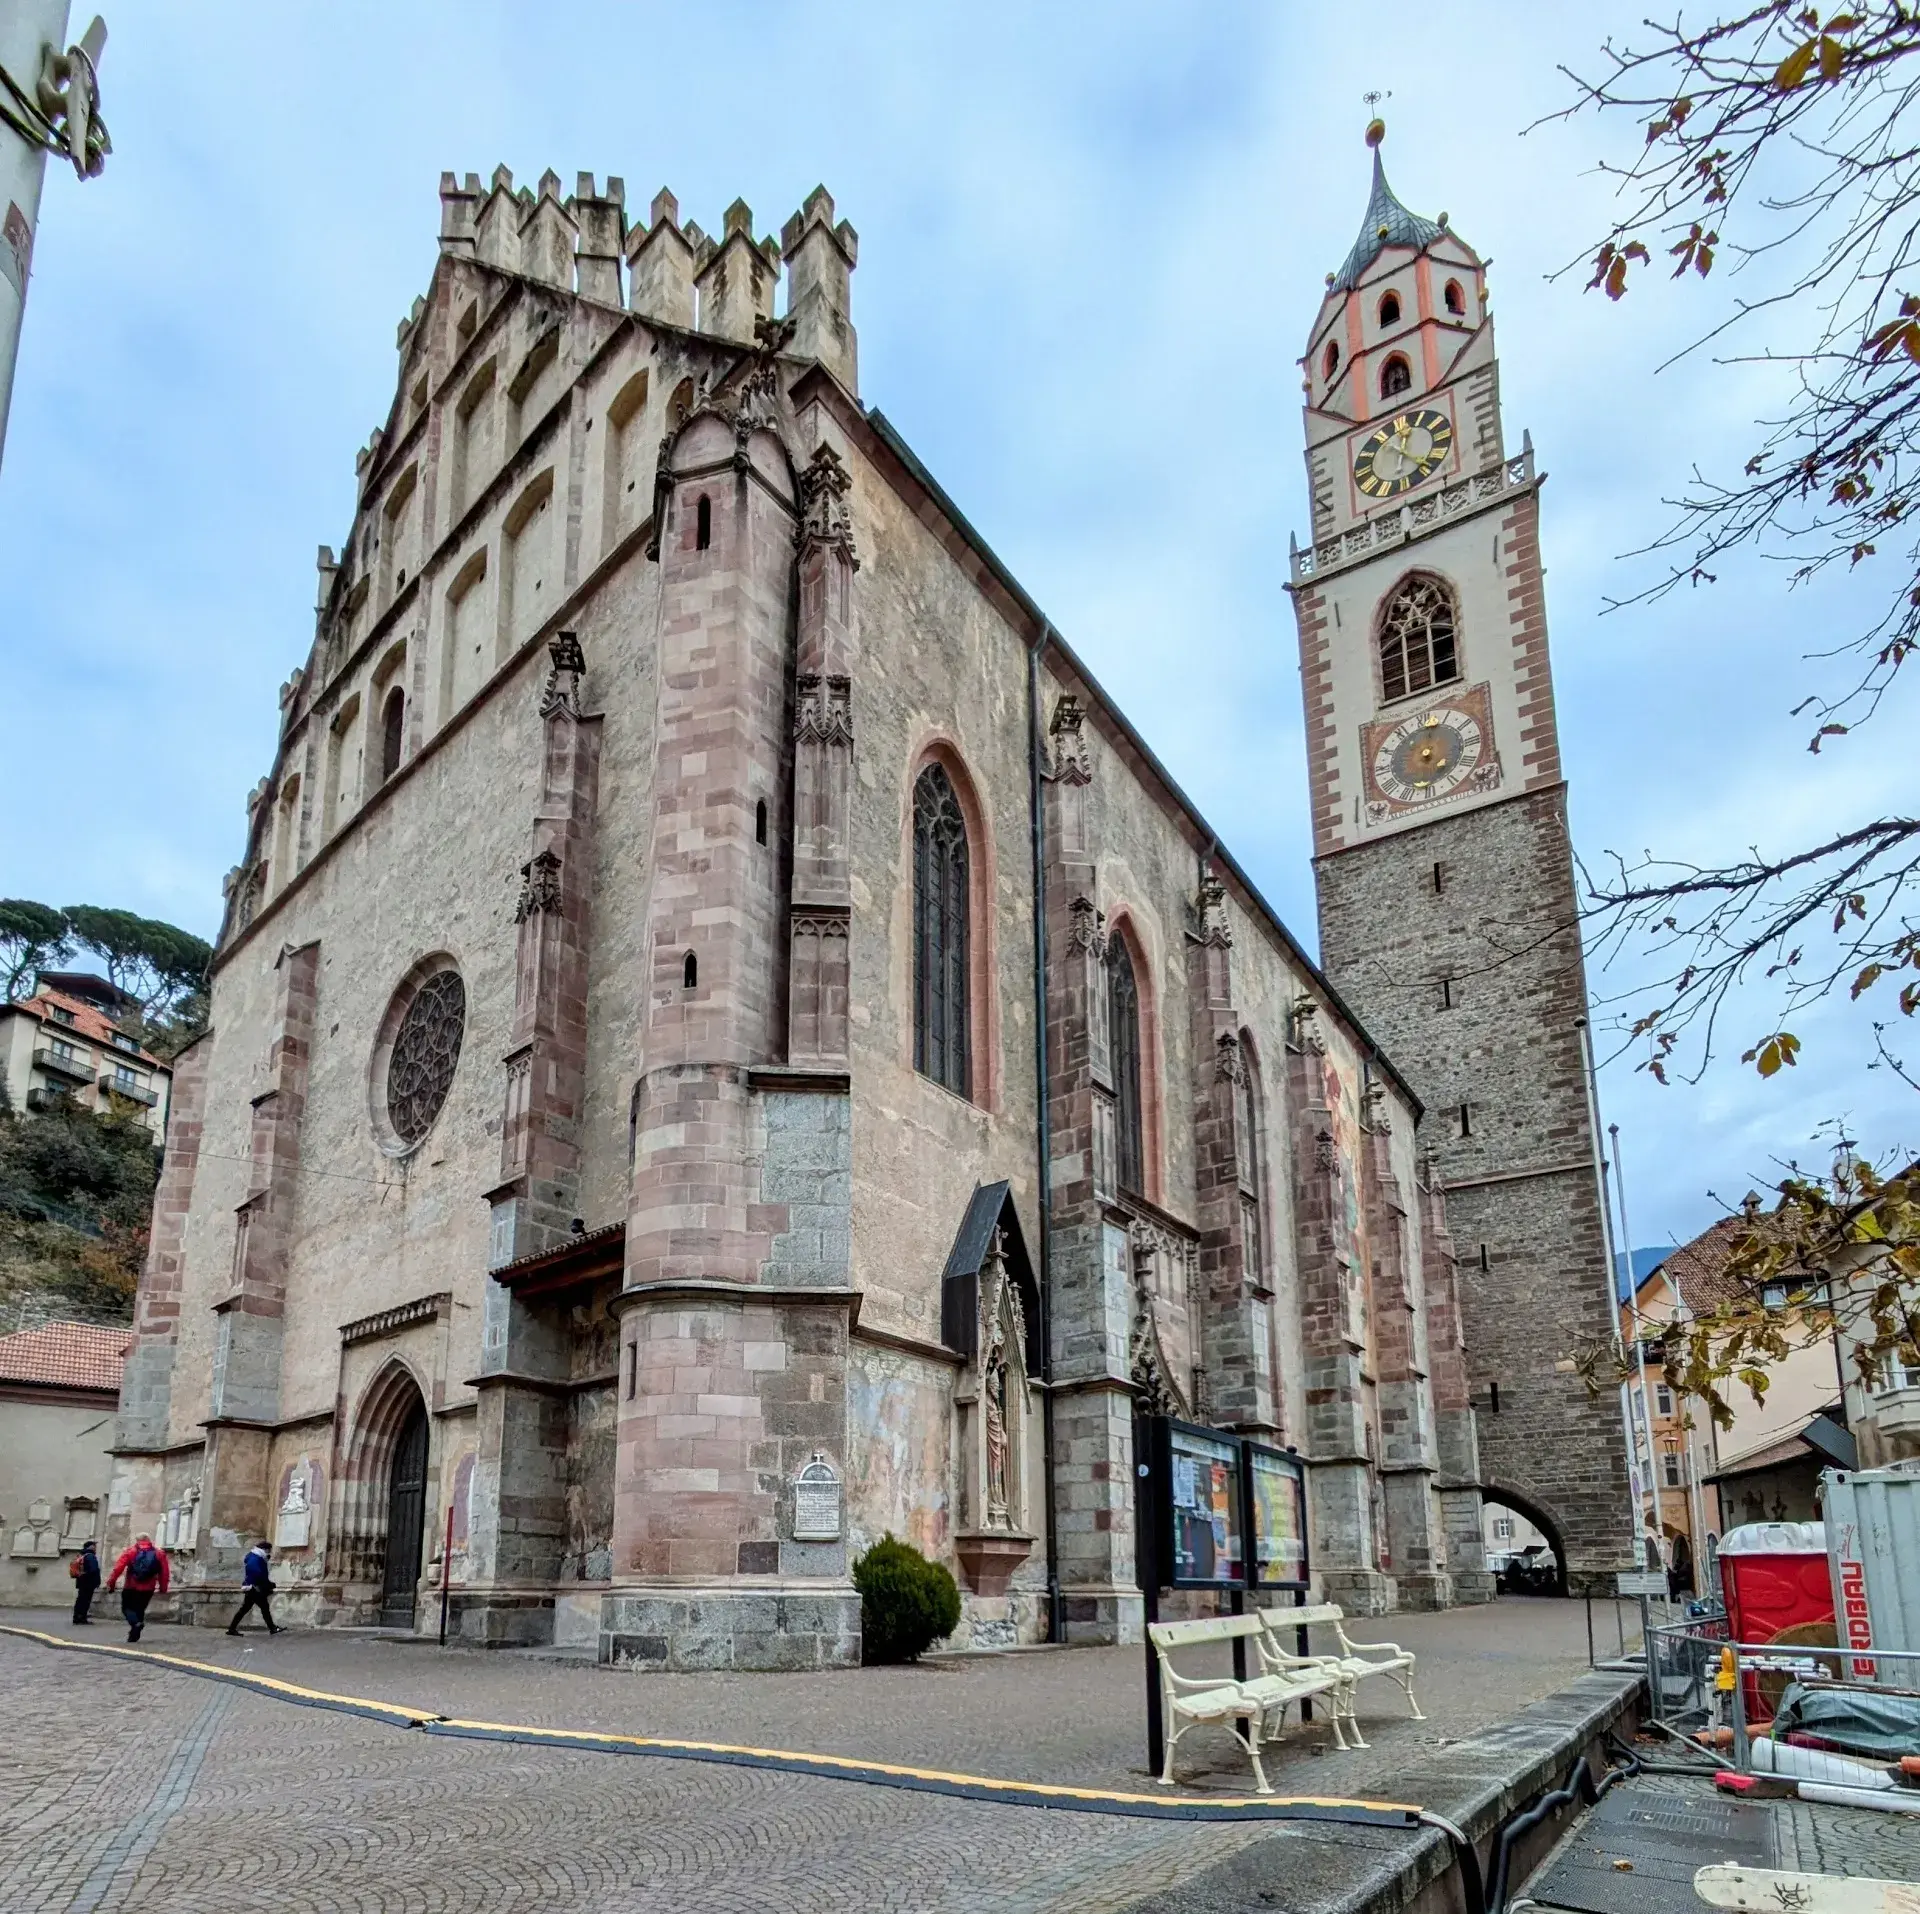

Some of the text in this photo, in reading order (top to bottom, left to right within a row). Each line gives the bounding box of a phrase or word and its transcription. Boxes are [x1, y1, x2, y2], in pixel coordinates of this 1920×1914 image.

[1414, 411, 1425, 427] I
[1442, 710, 1451, 724] I
[1457, 718, 1472, 731] II
[1394, 725, 1409, 740] XI
[1464, 734, 1480, 747] III
[1380, 747, 1394, 755] X
[1459, 755, 1477, 767] IIII
[1375, 764, 1391, 776] IX
[1381, 778, 1399, 795] VIII
[1447, 775, 1459, 786] V
[1840, 1561, 1875, 1676] ERDBAU
